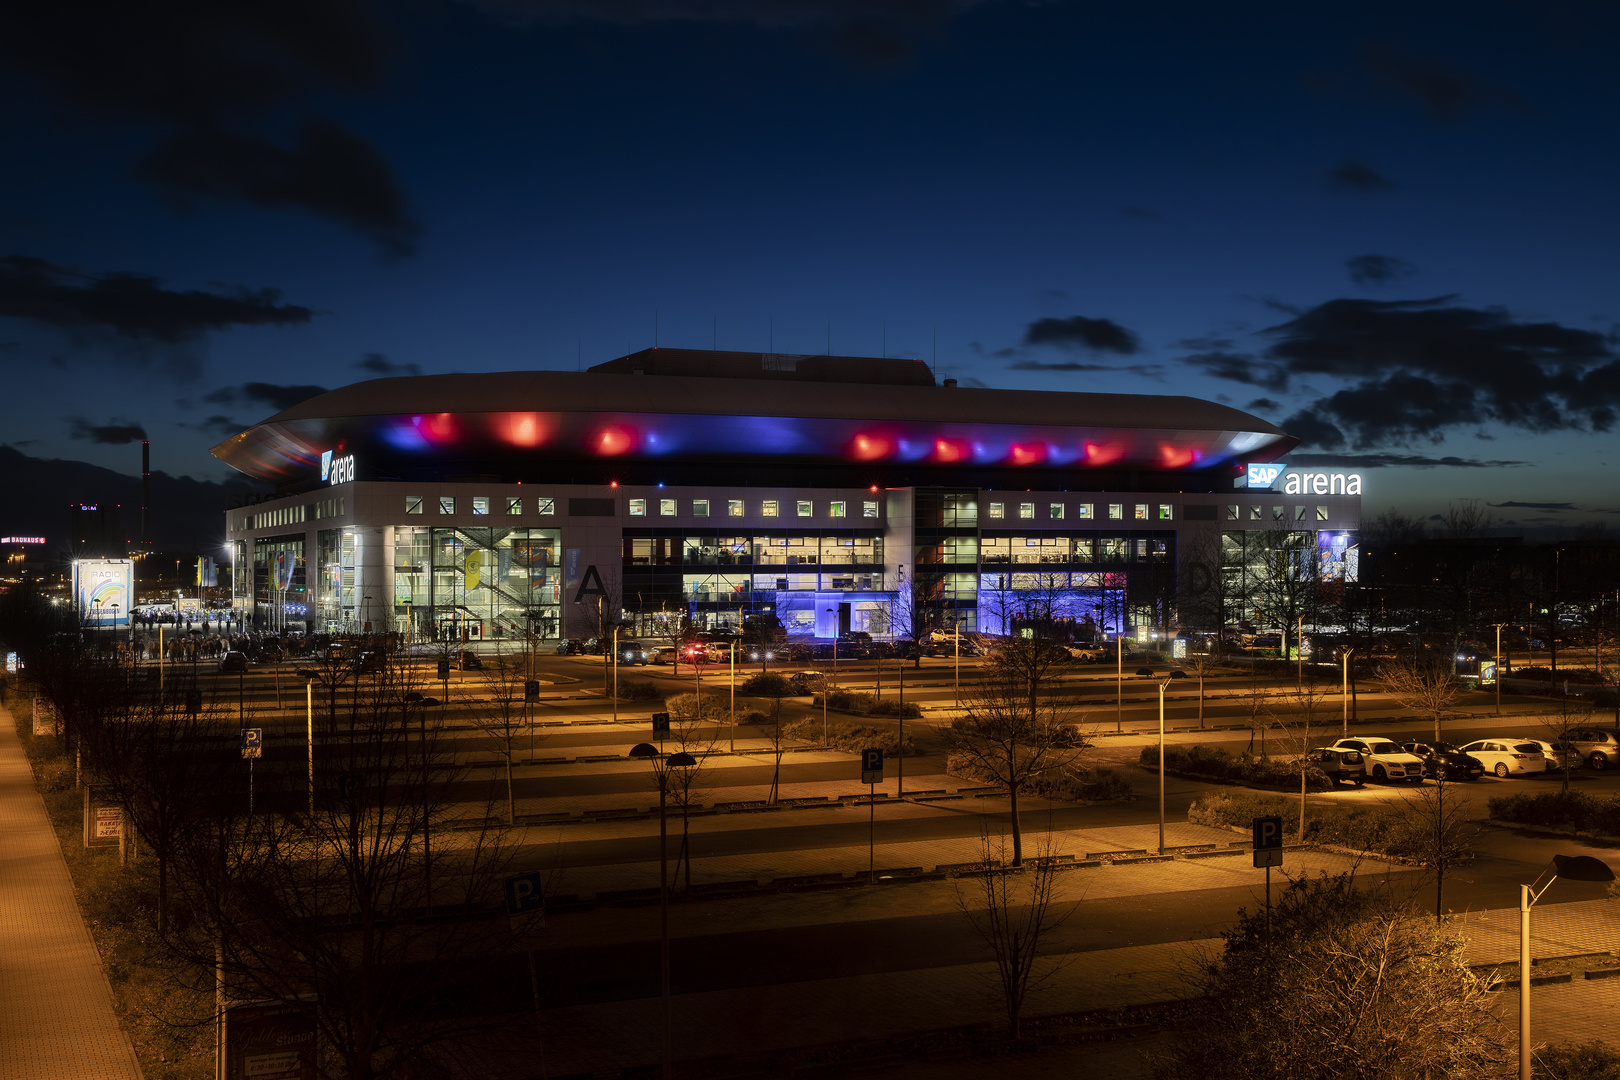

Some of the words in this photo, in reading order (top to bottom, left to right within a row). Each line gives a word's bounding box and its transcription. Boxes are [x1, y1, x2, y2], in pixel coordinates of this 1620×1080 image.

[331, 455, 354, 486] arena
[1249, 467, 1278, 484] SAP
[1285, 472, 1362, 495] arena
[574, 565, 610, 603] A
[246, 731, 257, 746] P
[868, 752, 879, 769] P
[1262, 822, 1276, 846] P
[514, 880, 533, 909] P
